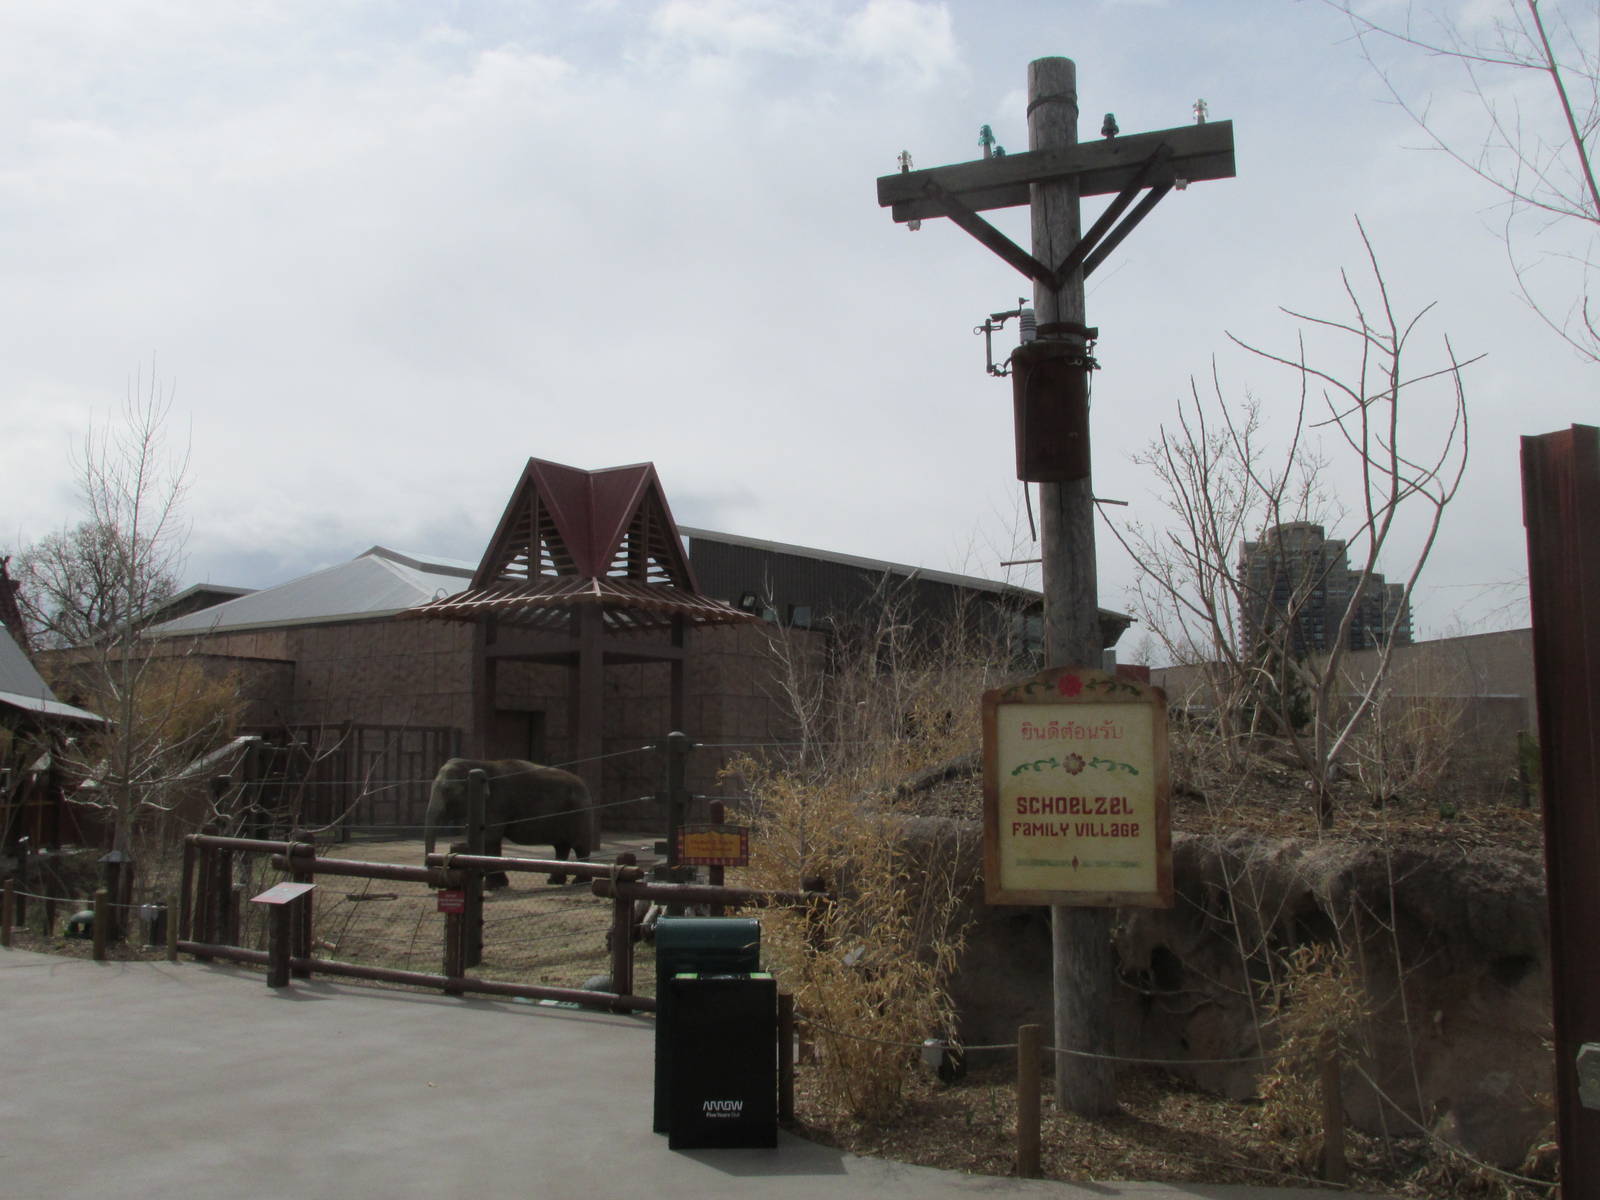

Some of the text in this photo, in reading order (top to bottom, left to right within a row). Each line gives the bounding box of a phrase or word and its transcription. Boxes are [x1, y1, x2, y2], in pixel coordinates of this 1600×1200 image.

[1016, 796, 1134, 815] SCHOELZEL
[1012, 822, 1140, 837] FAMILY VILLAGE
[703, 1100, 743, 1111] ARROW
